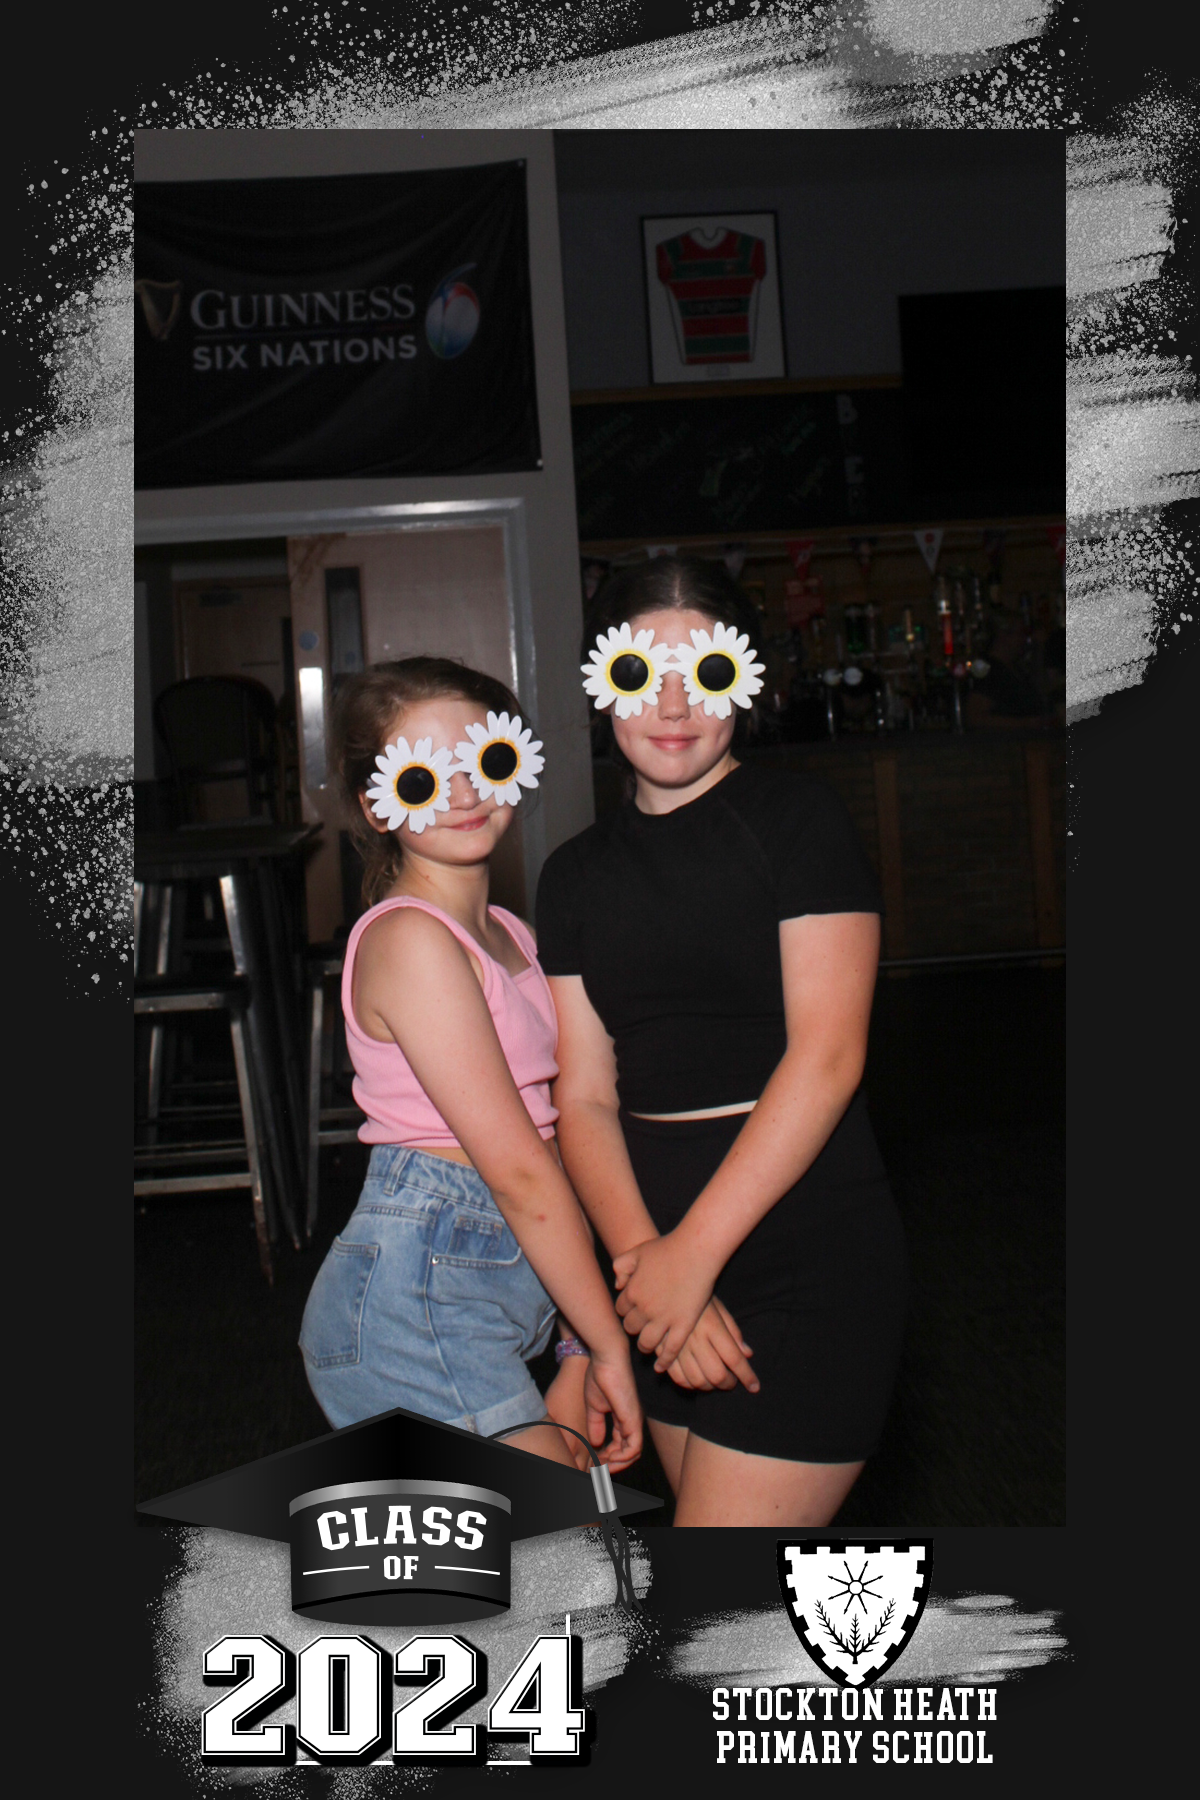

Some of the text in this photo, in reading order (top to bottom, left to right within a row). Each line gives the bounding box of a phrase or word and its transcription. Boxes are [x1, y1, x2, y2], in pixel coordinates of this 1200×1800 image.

[190, 284, 417, 330] GUINNESS
[192, 335, 418, 371] SIX NATIONS
